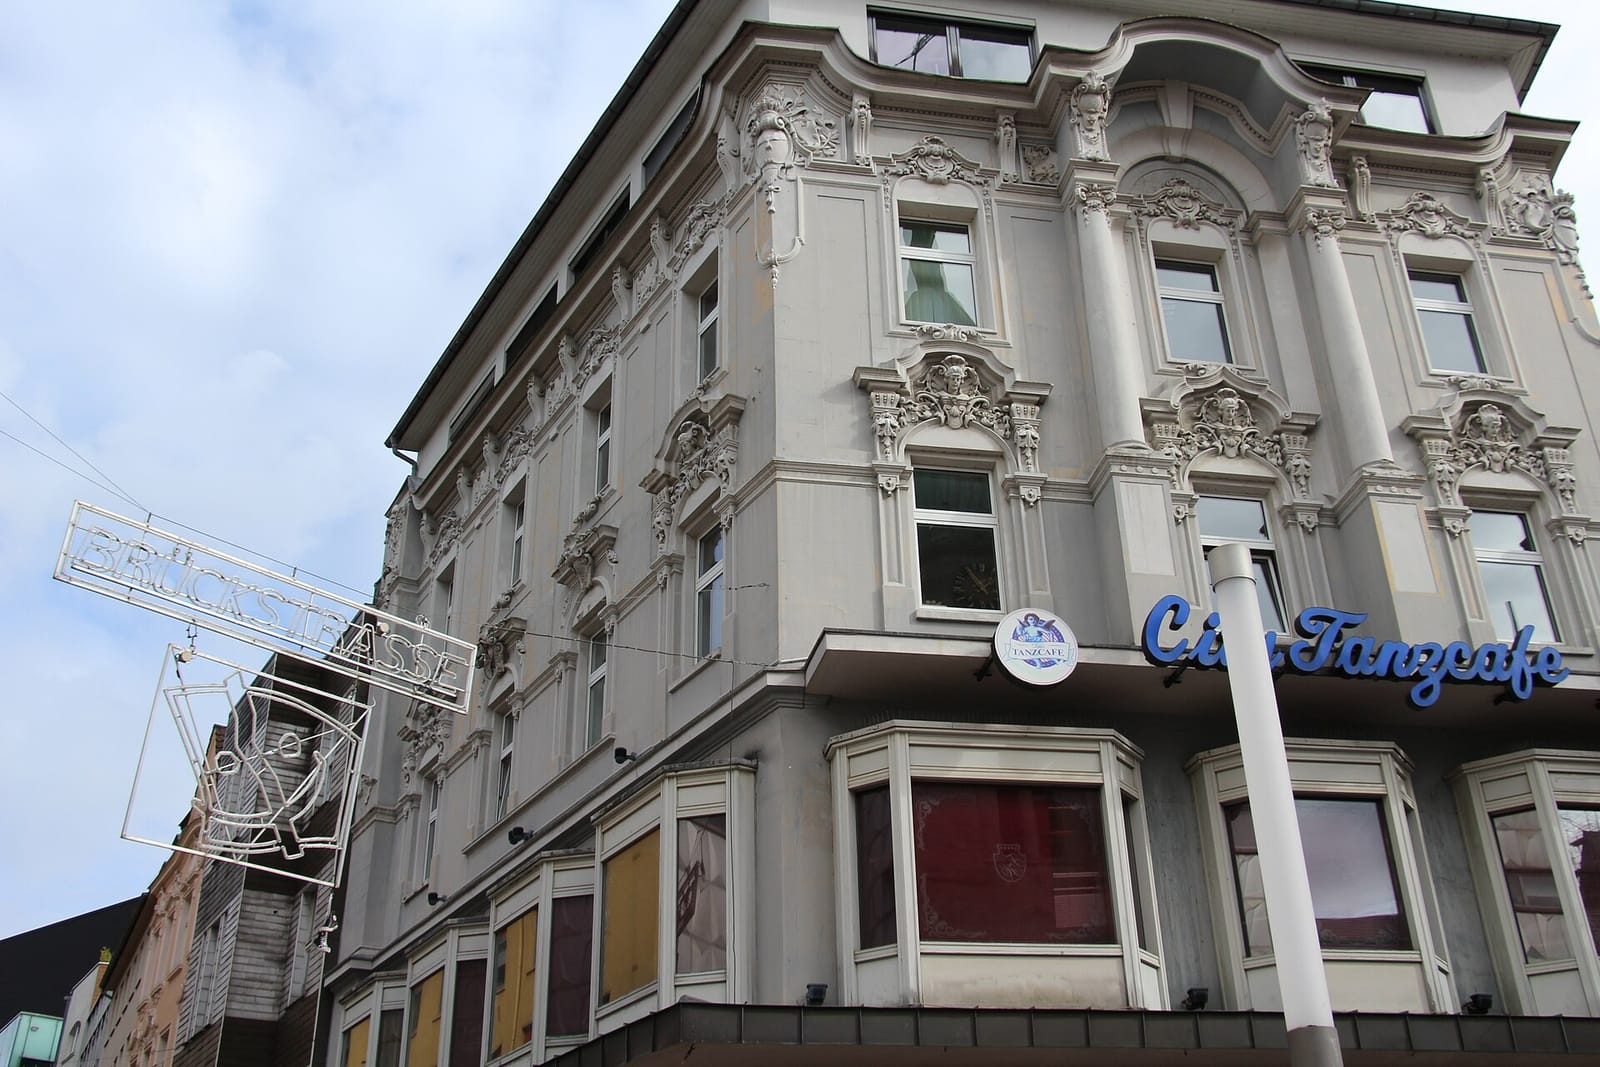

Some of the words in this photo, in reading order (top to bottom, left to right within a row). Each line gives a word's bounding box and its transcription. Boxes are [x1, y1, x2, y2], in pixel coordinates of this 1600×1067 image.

[75, 526, 470, 693] BRÜCKSTRASSE
[1012, 647, 1065, 657] TANZCAFE
[1142, 594, 1285, 672] Ci
[1290, 606, 1570, 708] Tanzcafe
